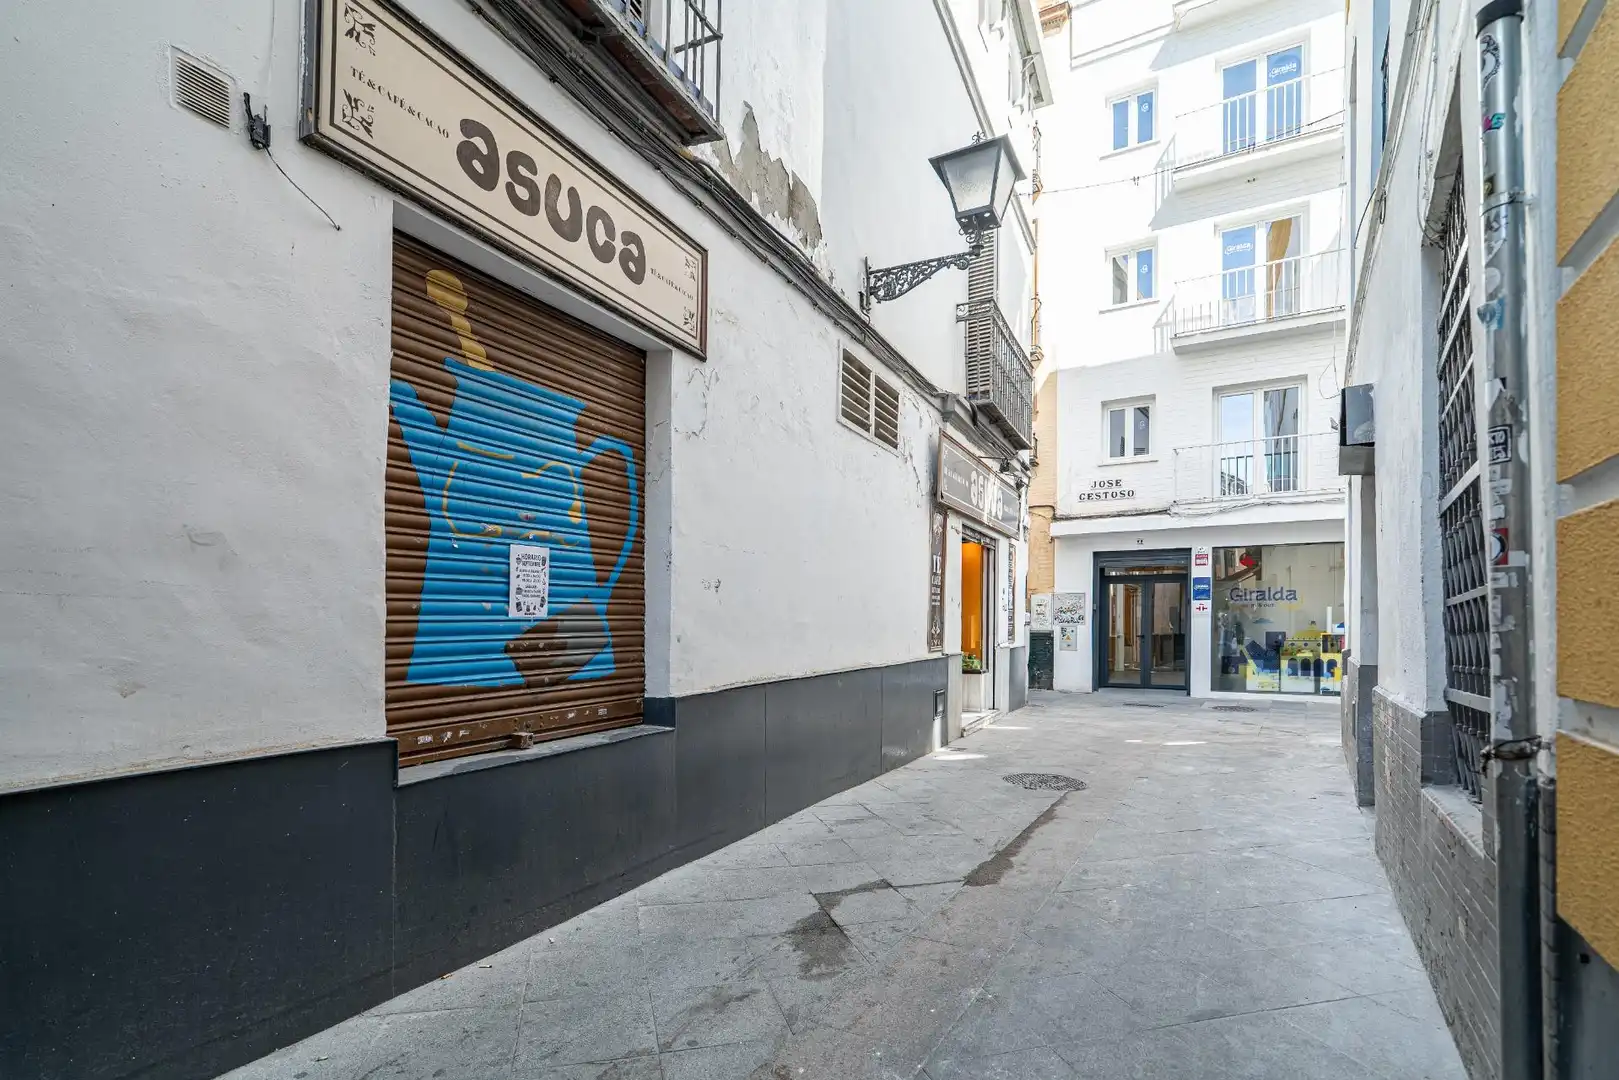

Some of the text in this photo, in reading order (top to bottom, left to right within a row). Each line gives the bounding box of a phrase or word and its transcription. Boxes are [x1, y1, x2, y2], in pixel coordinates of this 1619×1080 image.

[456, 118, 646, 286] asuca
[1090, 479, 1122, 489] JOSE
[1229, 586, 1298, 602] Giralda
